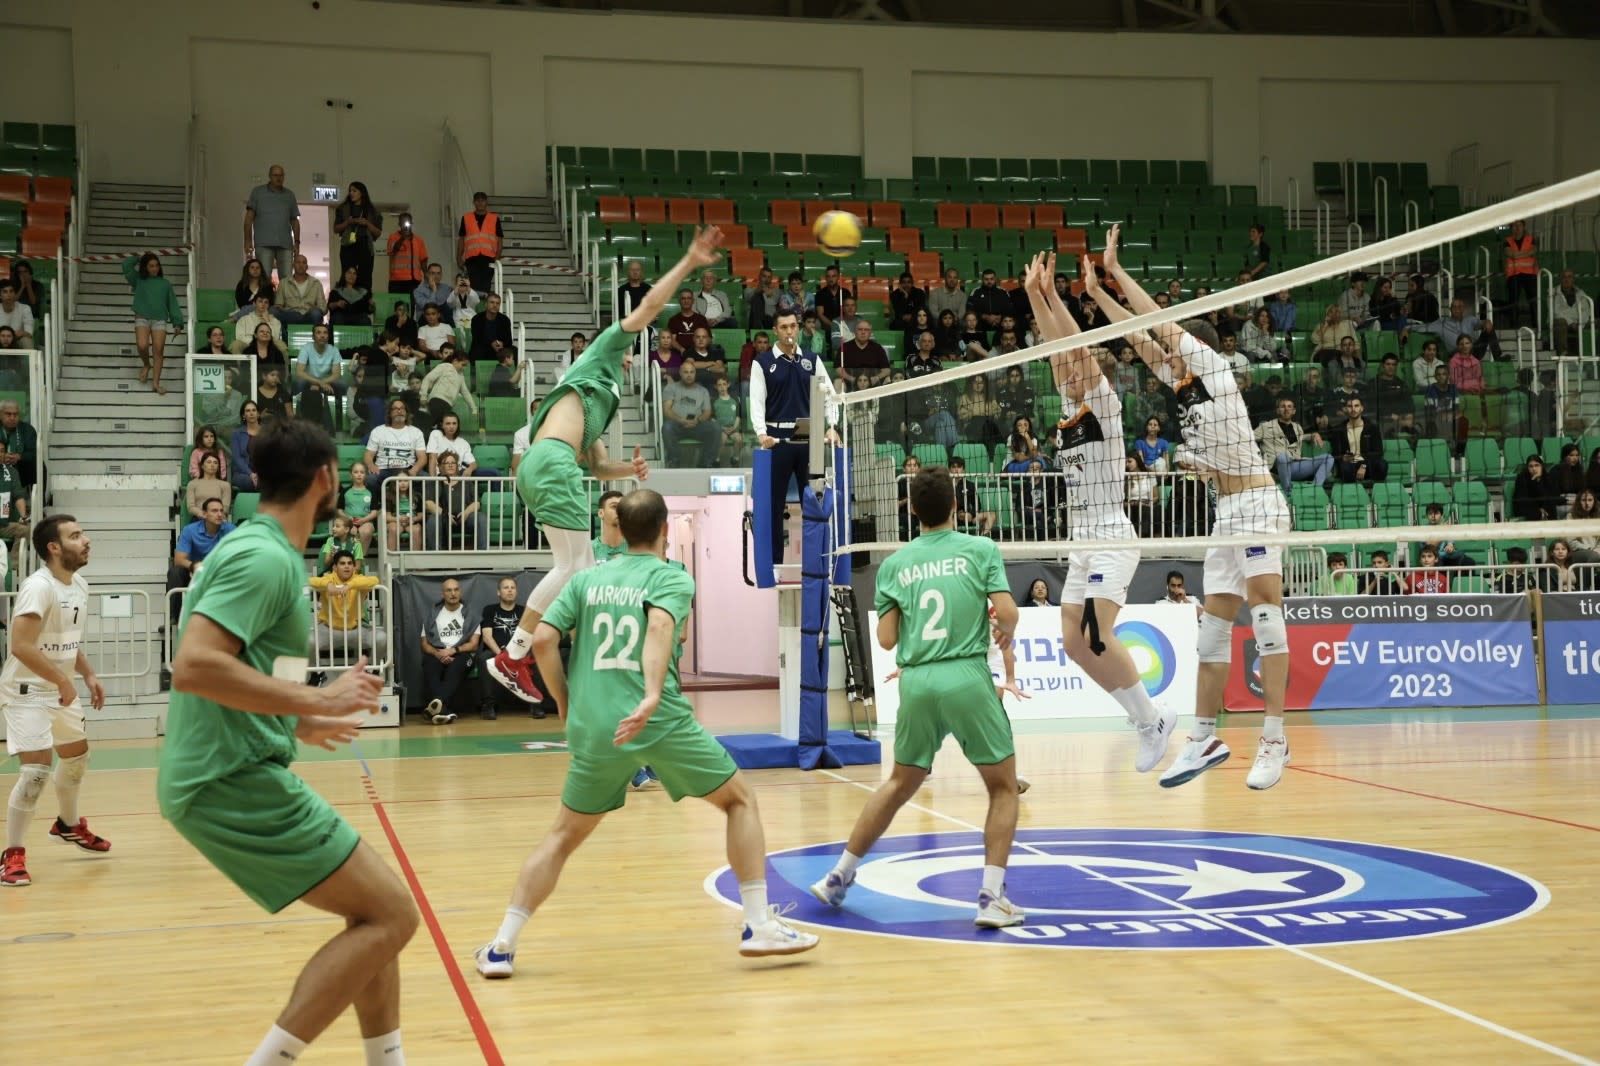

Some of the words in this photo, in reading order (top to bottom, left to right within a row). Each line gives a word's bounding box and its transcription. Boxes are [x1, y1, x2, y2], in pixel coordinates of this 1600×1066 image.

[197, 367, 221, 377] שער
[203, 380, 217, 391] ב
[897, 556, 968, 588] MAINER
[73, 606, 79, 624] 7
[920, 589, 947, 640] 2
[1284, 603, 1333, 619] kets
[1341, 601, 1428, 621] coming
[1436, 603, 1493, 617] soon
[592, 612, 640, 672] 22
[1312, 641, 1373, 666] CEV
[1379, 639, 1523, 668] EuroVolley
[1389, 673, 1453, 698] 2023
[999, 917, 1223, 939] הפיס
[1216, 907, 1467, 927] מפעל
